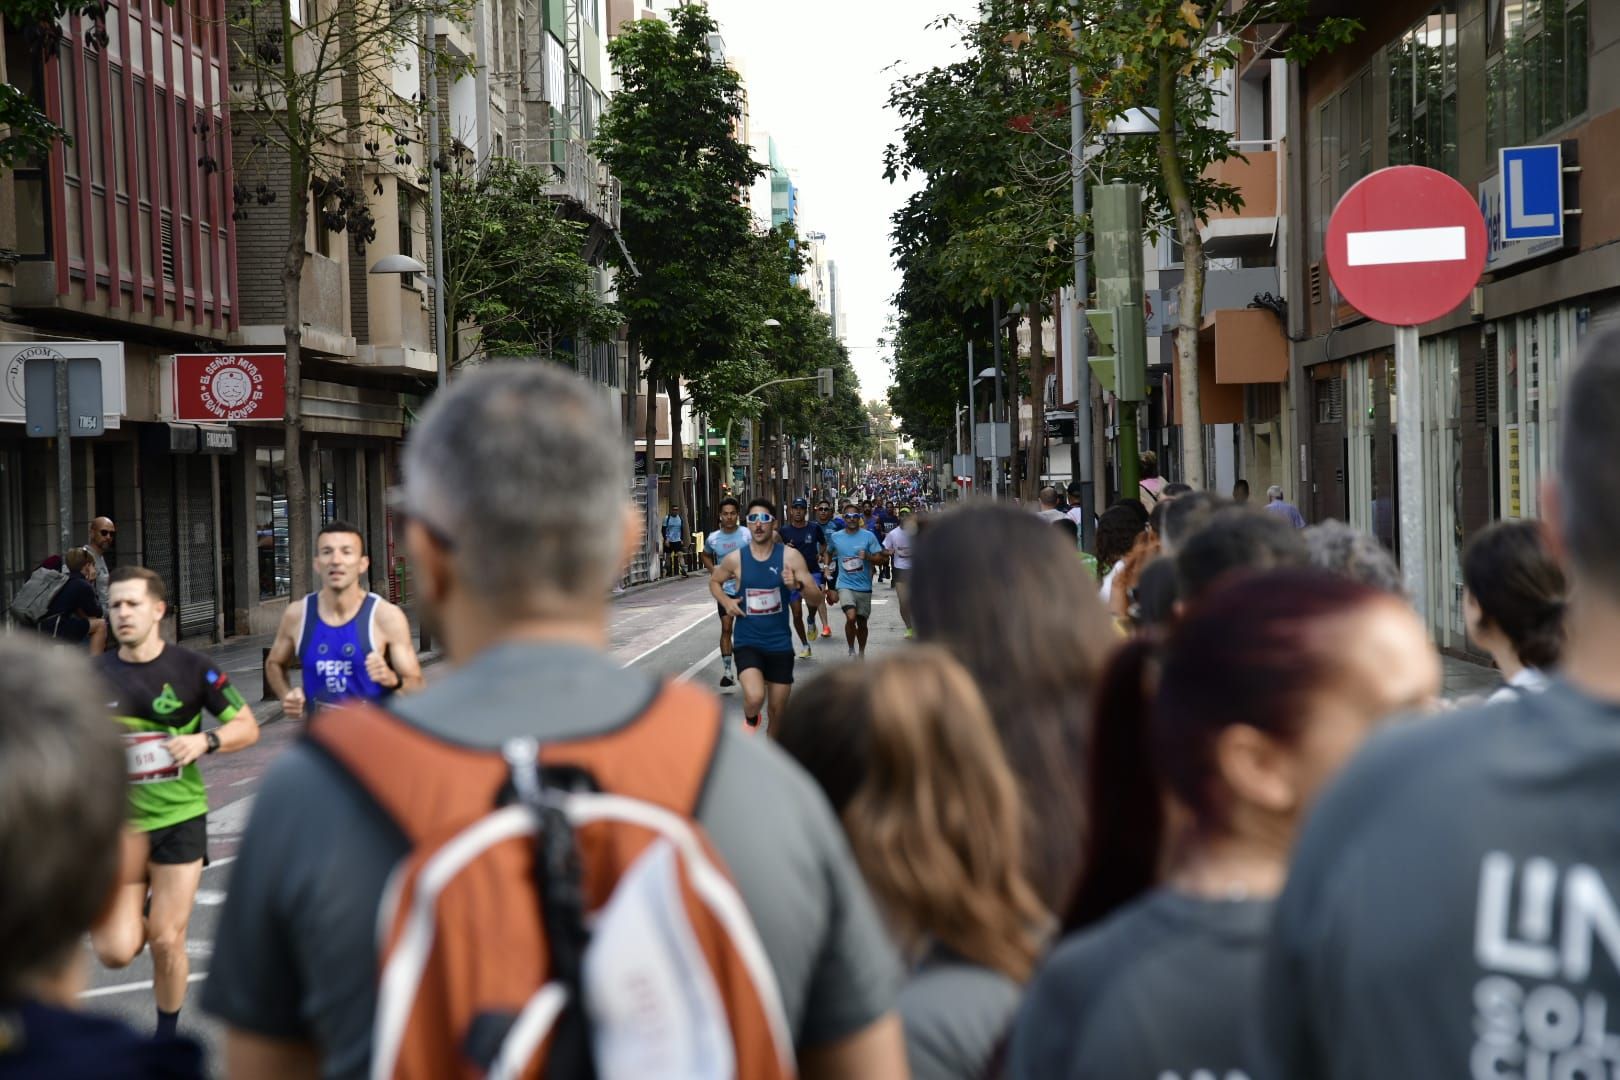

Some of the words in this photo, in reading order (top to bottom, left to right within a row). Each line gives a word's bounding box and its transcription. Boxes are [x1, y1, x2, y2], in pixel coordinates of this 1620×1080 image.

[1509, 159, 1555, 229] L
[205, 356, 236, 375] SEÑOR
[200, 375, 211, 385] EL
[316, 660, 353, 676] PEPE
